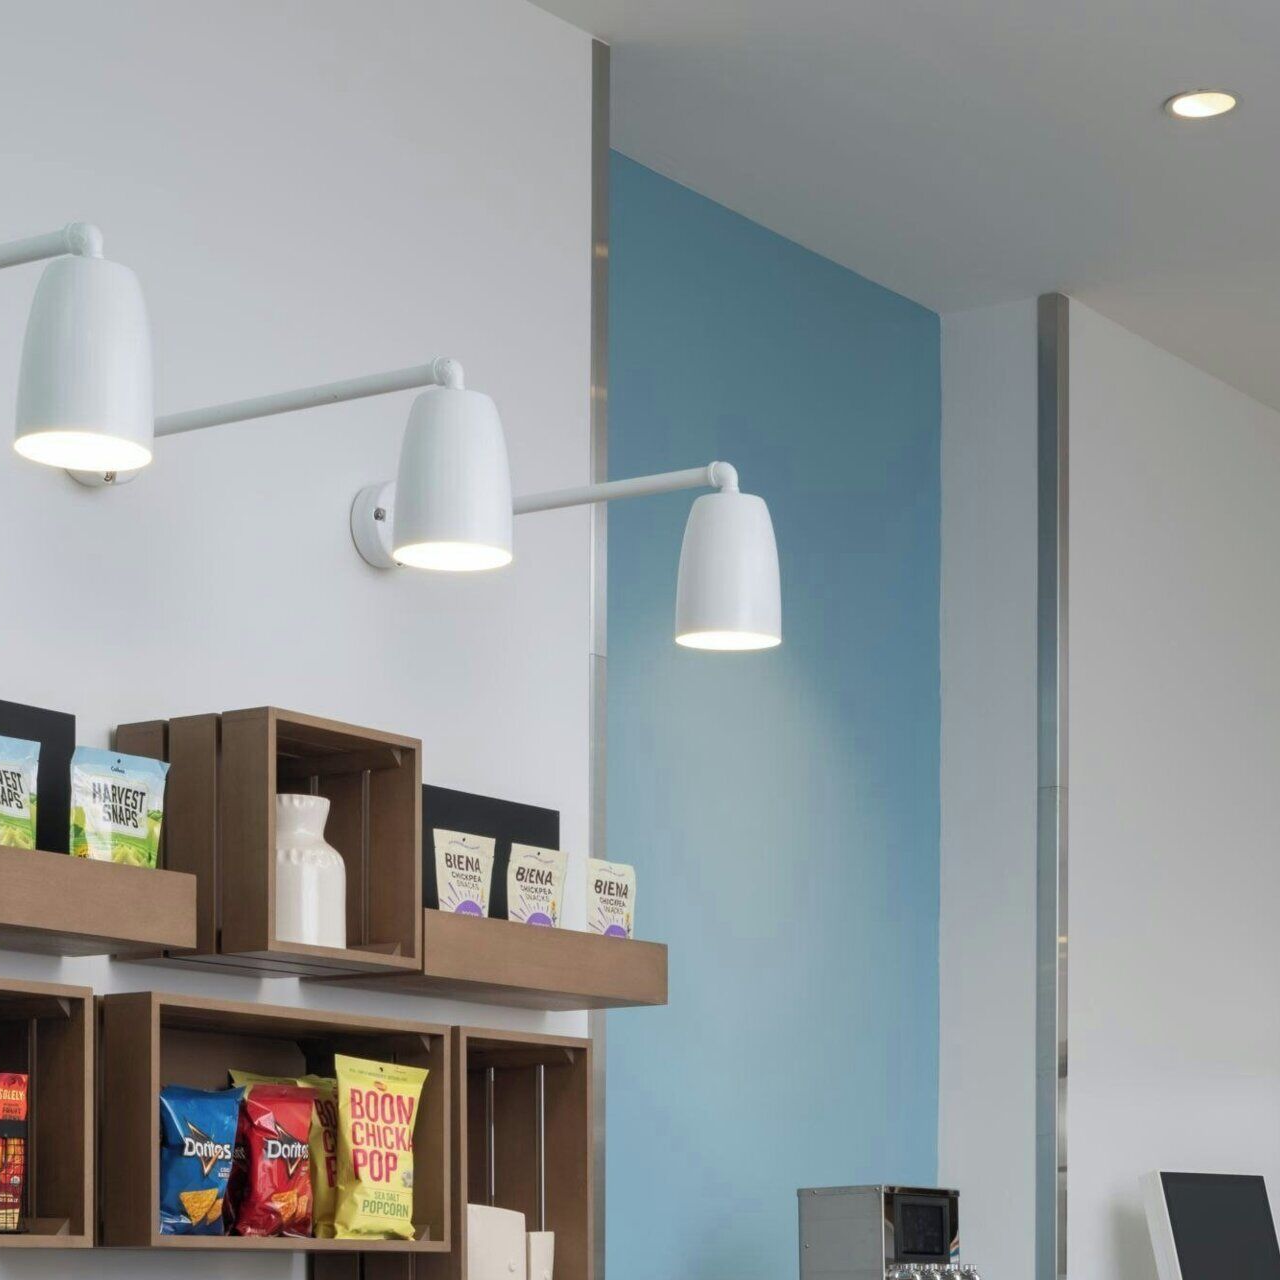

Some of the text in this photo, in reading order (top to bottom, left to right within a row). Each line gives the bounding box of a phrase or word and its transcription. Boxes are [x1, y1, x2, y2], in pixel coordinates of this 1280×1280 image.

[92, 782, 146, 813] HARVEST
[102, 804, 139, 828] SNAPS
[445, 853, 482, 873] BIENA
[516, 866, 553, 886] BIENA
[594, 879, 629, 898] BIENA
[183, 1138, 232, 1160] Doritos
[352, 1149, 398, 1183] POP
[362, 1199, 410, 1218] POPCORN
